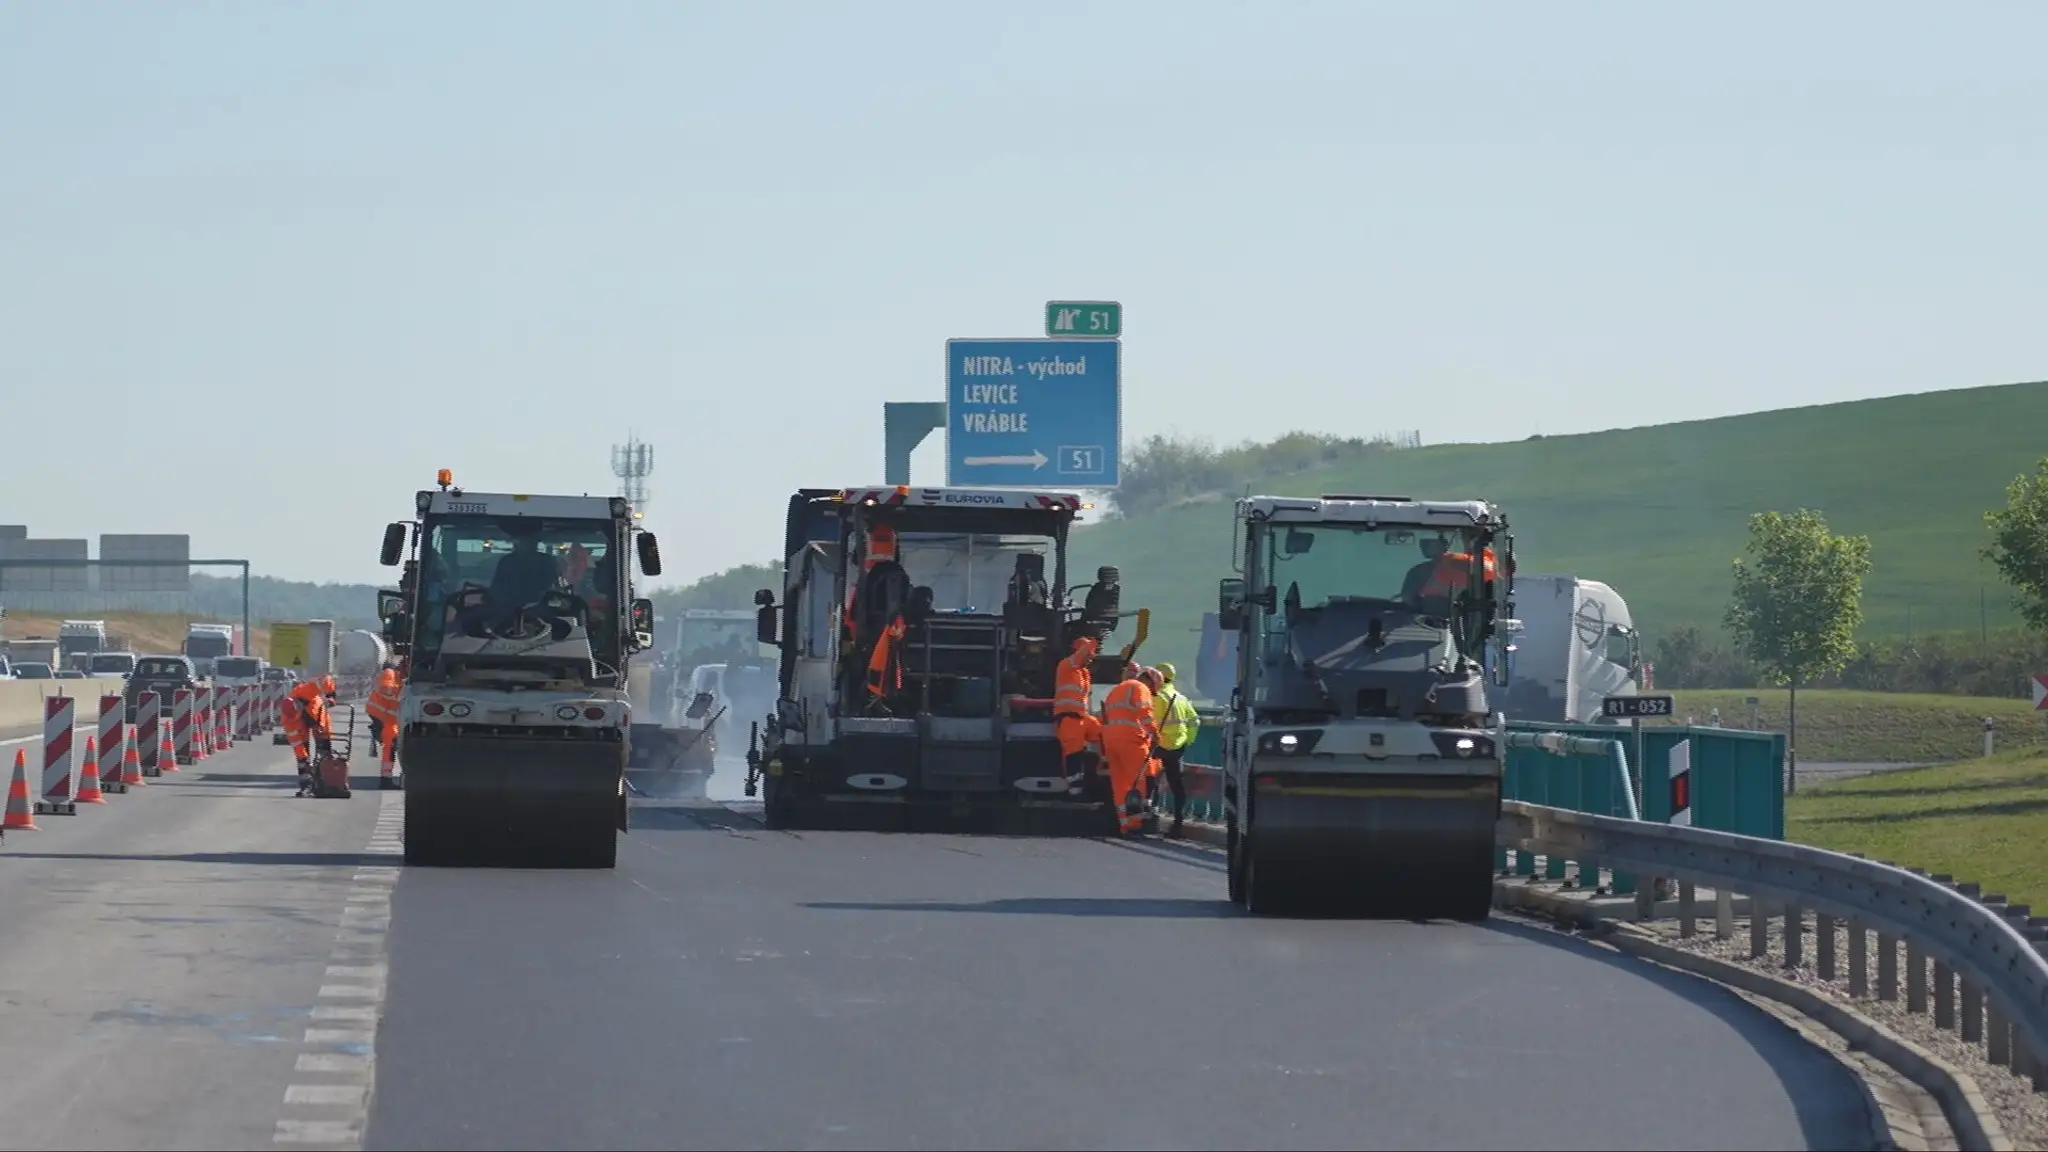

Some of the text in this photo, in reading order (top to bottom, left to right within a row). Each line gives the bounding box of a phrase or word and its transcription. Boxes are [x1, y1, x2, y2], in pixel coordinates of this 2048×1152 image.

[1089, 311, 1110, 331] 51
[963, 356, 1014, 376] NITRA
[1027, 356, 1086, 380] východ
[963, 384, 1018, 405] LEVICE
[963, 409, 1028, 433] VRÁBLE
[1072, 450, 1093, 469] 51
[945, 494, 1005, 504] EUROVIA
[1608, 700, 1625, 714] R1
[1639, 699, 1667, 714] 052
